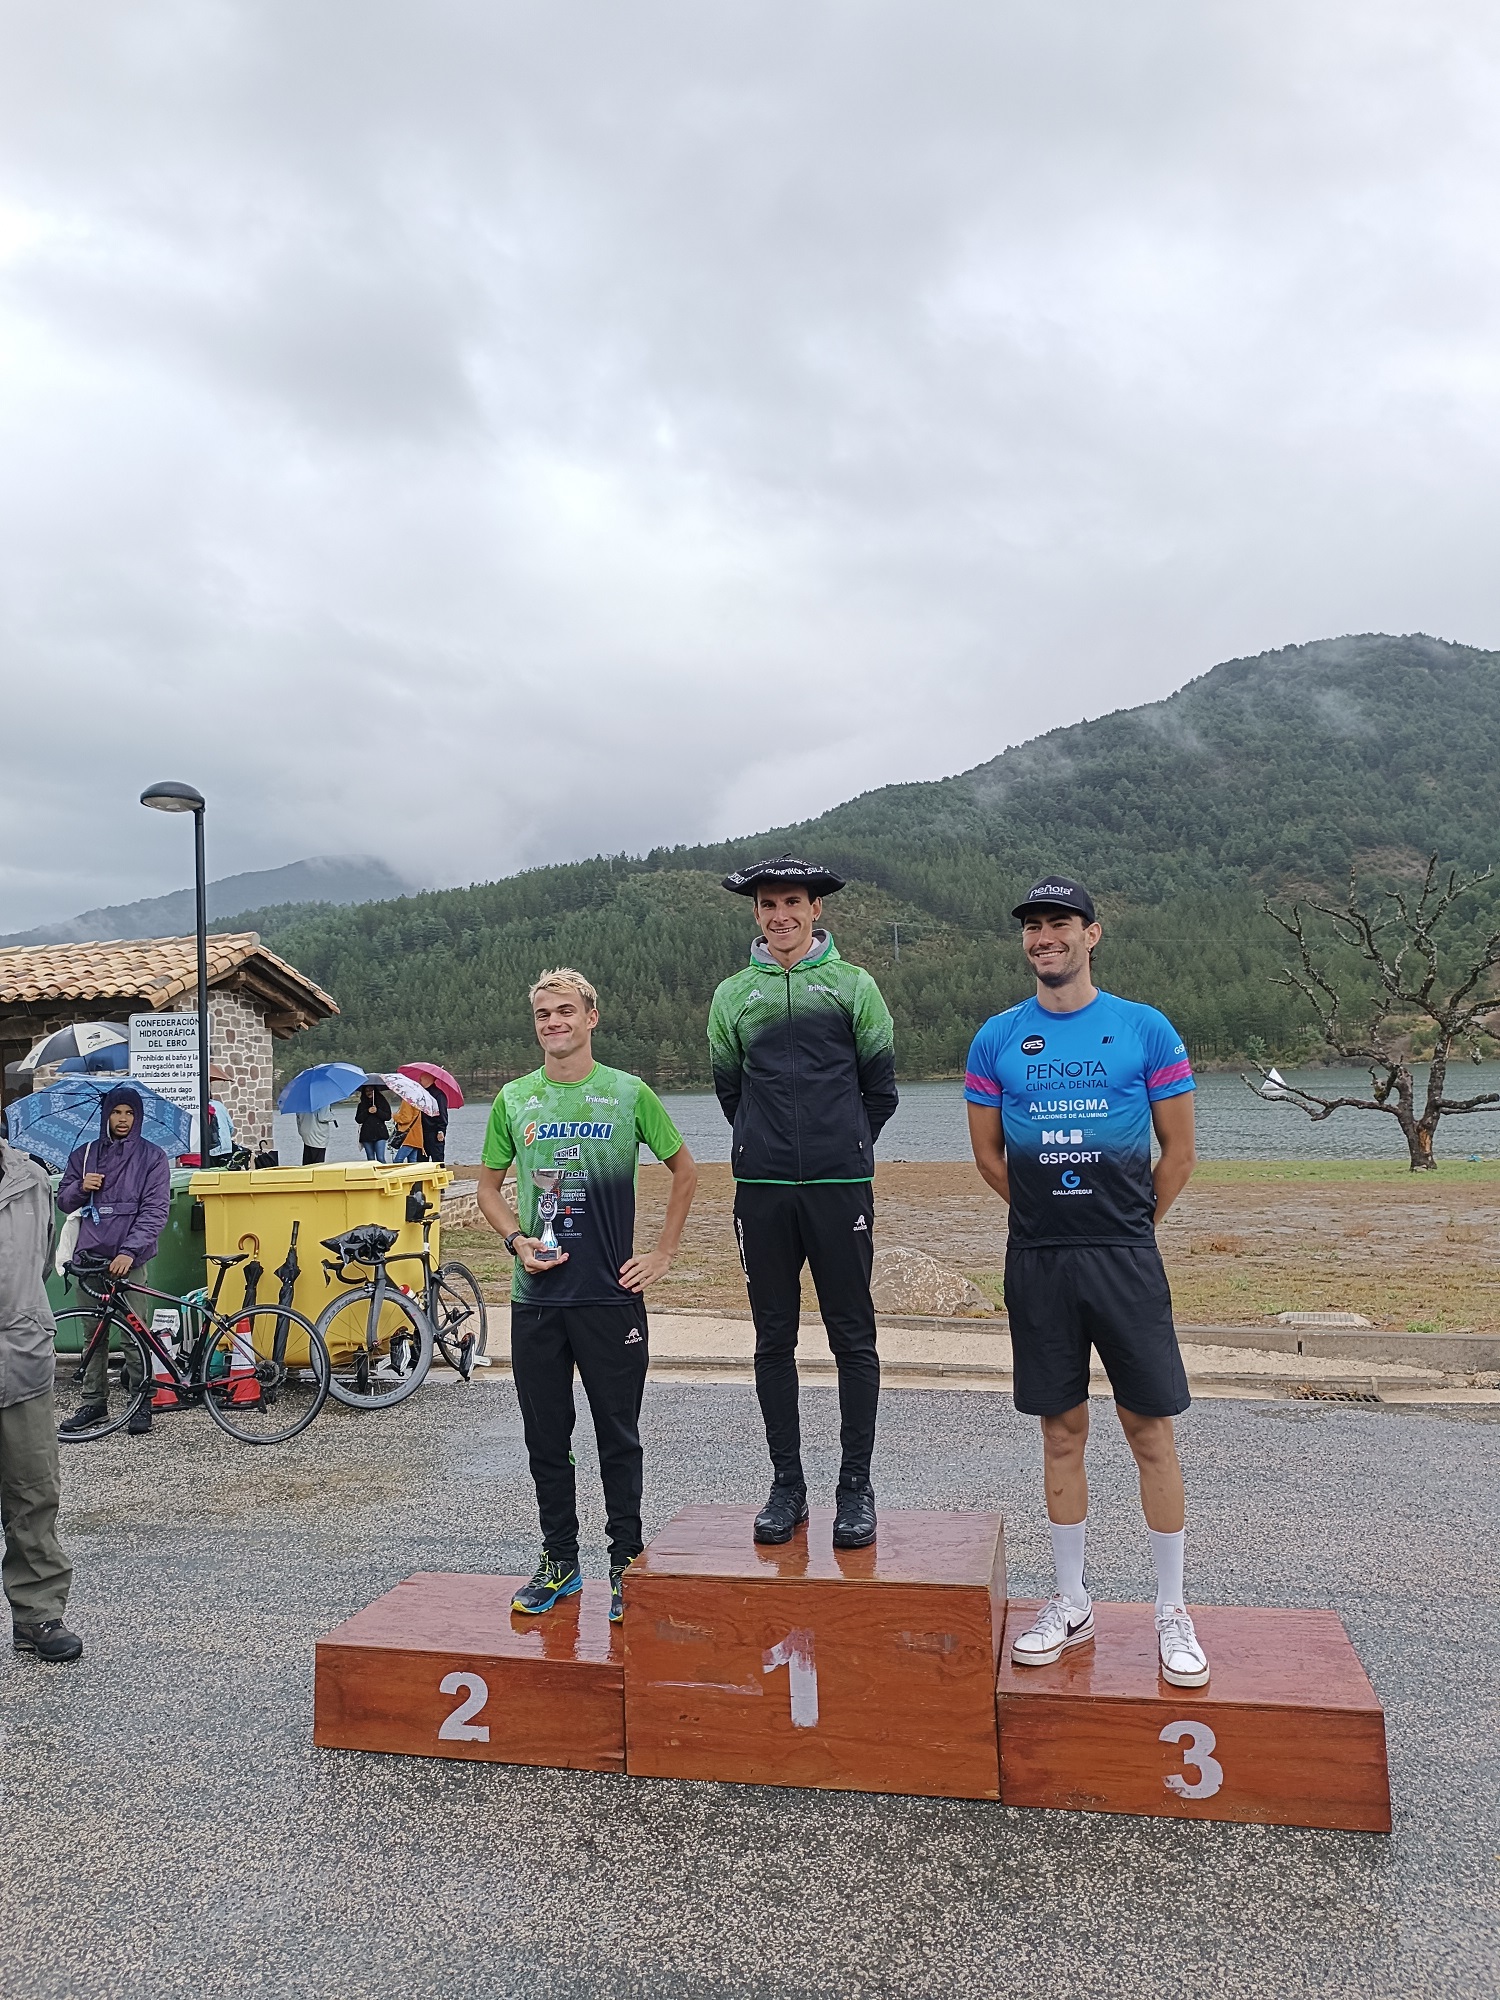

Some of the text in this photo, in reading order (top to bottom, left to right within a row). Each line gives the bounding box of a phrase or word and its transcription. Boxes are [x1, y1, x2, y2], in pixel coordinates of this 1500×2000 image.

[1029, 884, 1073, 899] peñota
[135, 1017, 200, 1028] CONFEDERACIÓN
[139, 1028, 196, 1037] HIDROGRÁFICA
[148, 1039, 188, 1048] DEL EBRO
[136, 1054, 164, 1062] Prohibido
[1025, 1058, 1108, 1080] PEÑOTA
[1025, 1079, 1109, 1092] CLÍNICA DENTAL
[1029, 1098, 1109, 1113] ALUSIGMA
[537, 1122, 613, 1140] SALTOKI
[1039, 1151, 1102, 1164] GSPORT
[761, 1626, 819, 1728] 1
[438, 1671, 490, 1743] 2
[1158, 1720, 1224, 1799] 3
